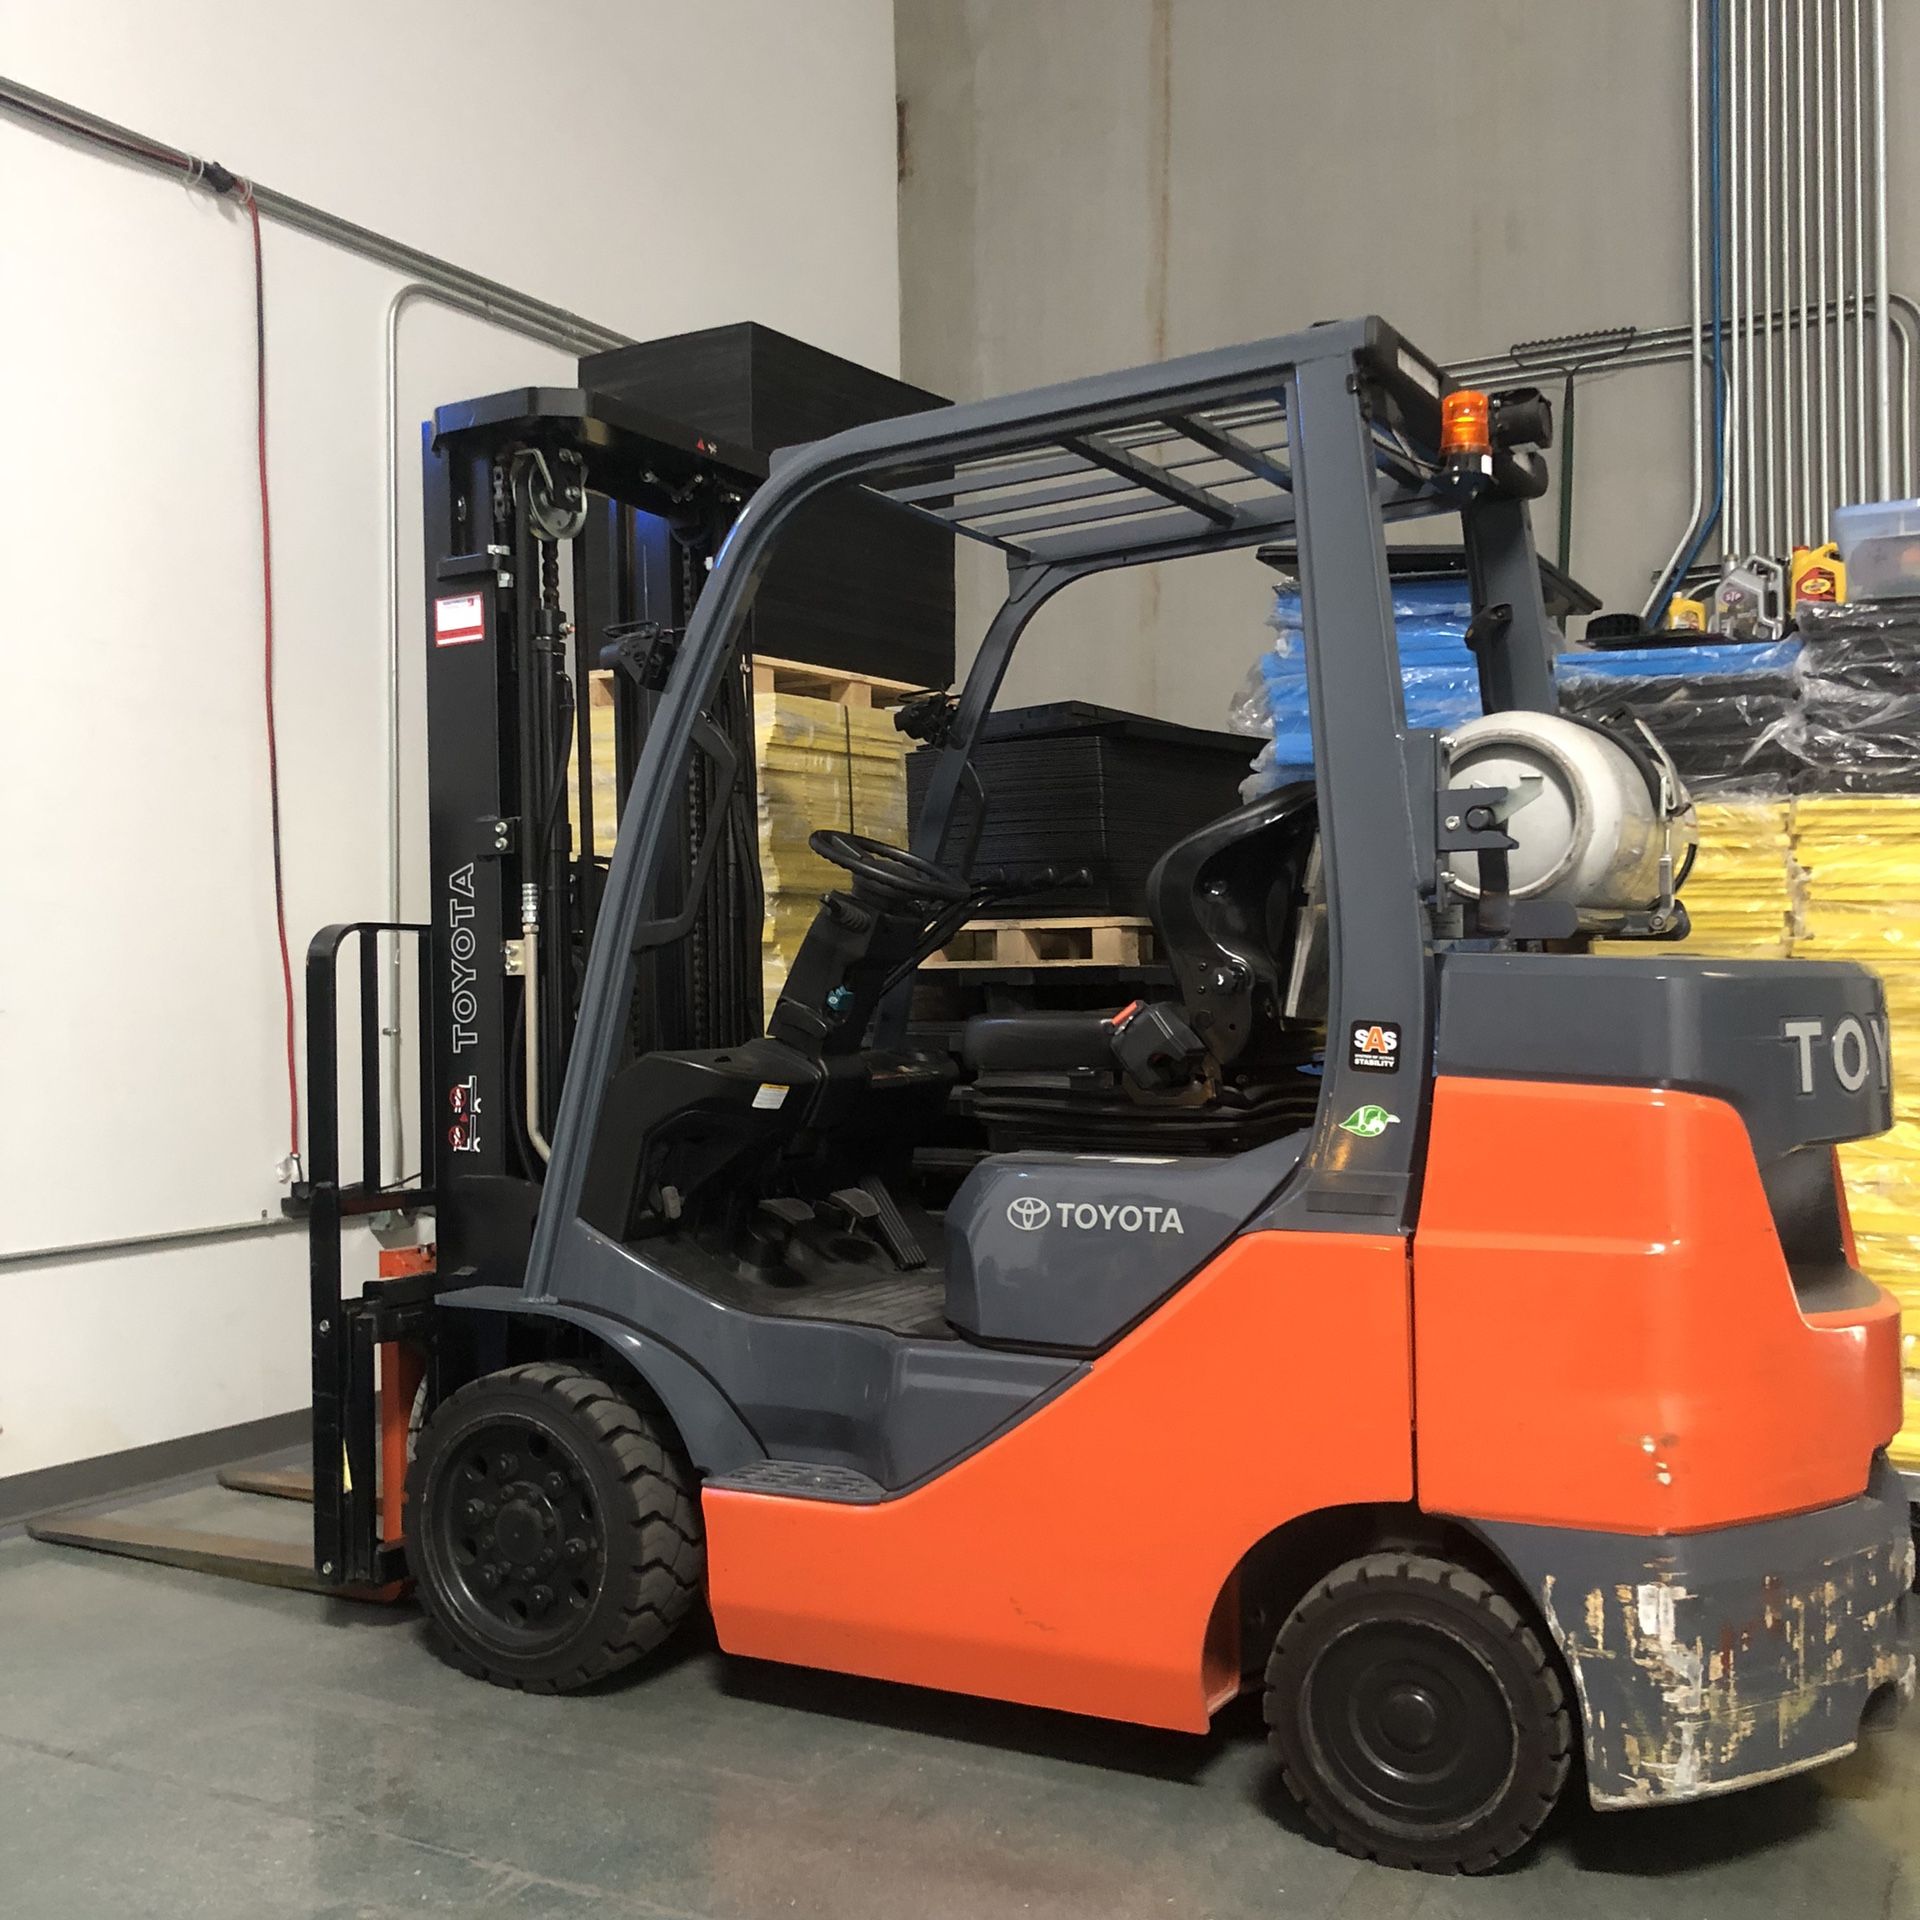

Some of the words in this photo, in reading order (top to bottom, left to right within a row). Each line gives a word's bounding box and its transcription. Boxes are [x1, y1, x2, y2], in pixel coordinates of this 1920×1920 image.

[449, 862, 478, 1053] TOYOTA
[1353, 1025, 1398, 1054] SAS
[1354, 1058, 1394, 1067] STABILITY
[1056, 1202, 1185, 1234] TOYOTA
